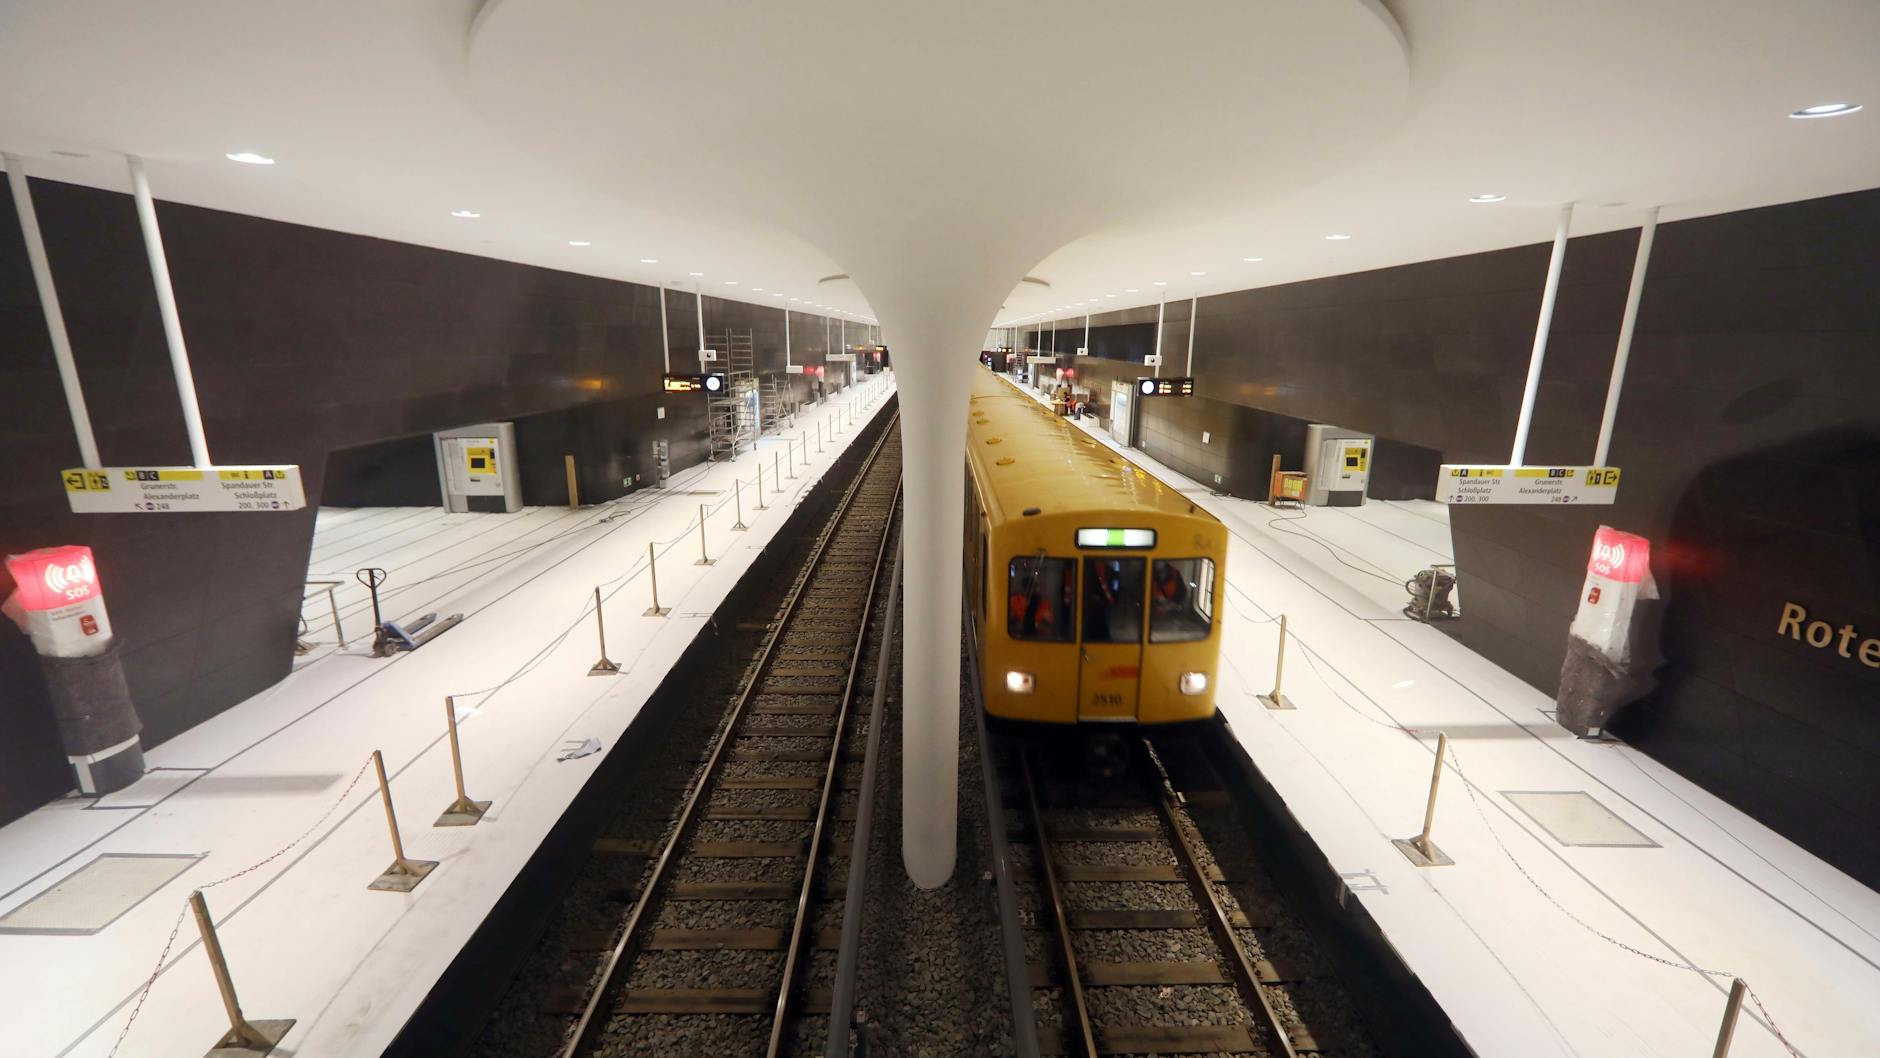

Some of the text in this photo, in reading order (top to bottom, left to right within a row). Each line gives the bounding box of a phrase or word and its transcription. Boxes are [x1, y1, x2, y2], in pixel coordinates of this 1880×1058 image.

[1594, 561, 1611, 575] SOS
[65, 585, 91, 600] SOS
[1777, 601, 1880, 668] Rote
